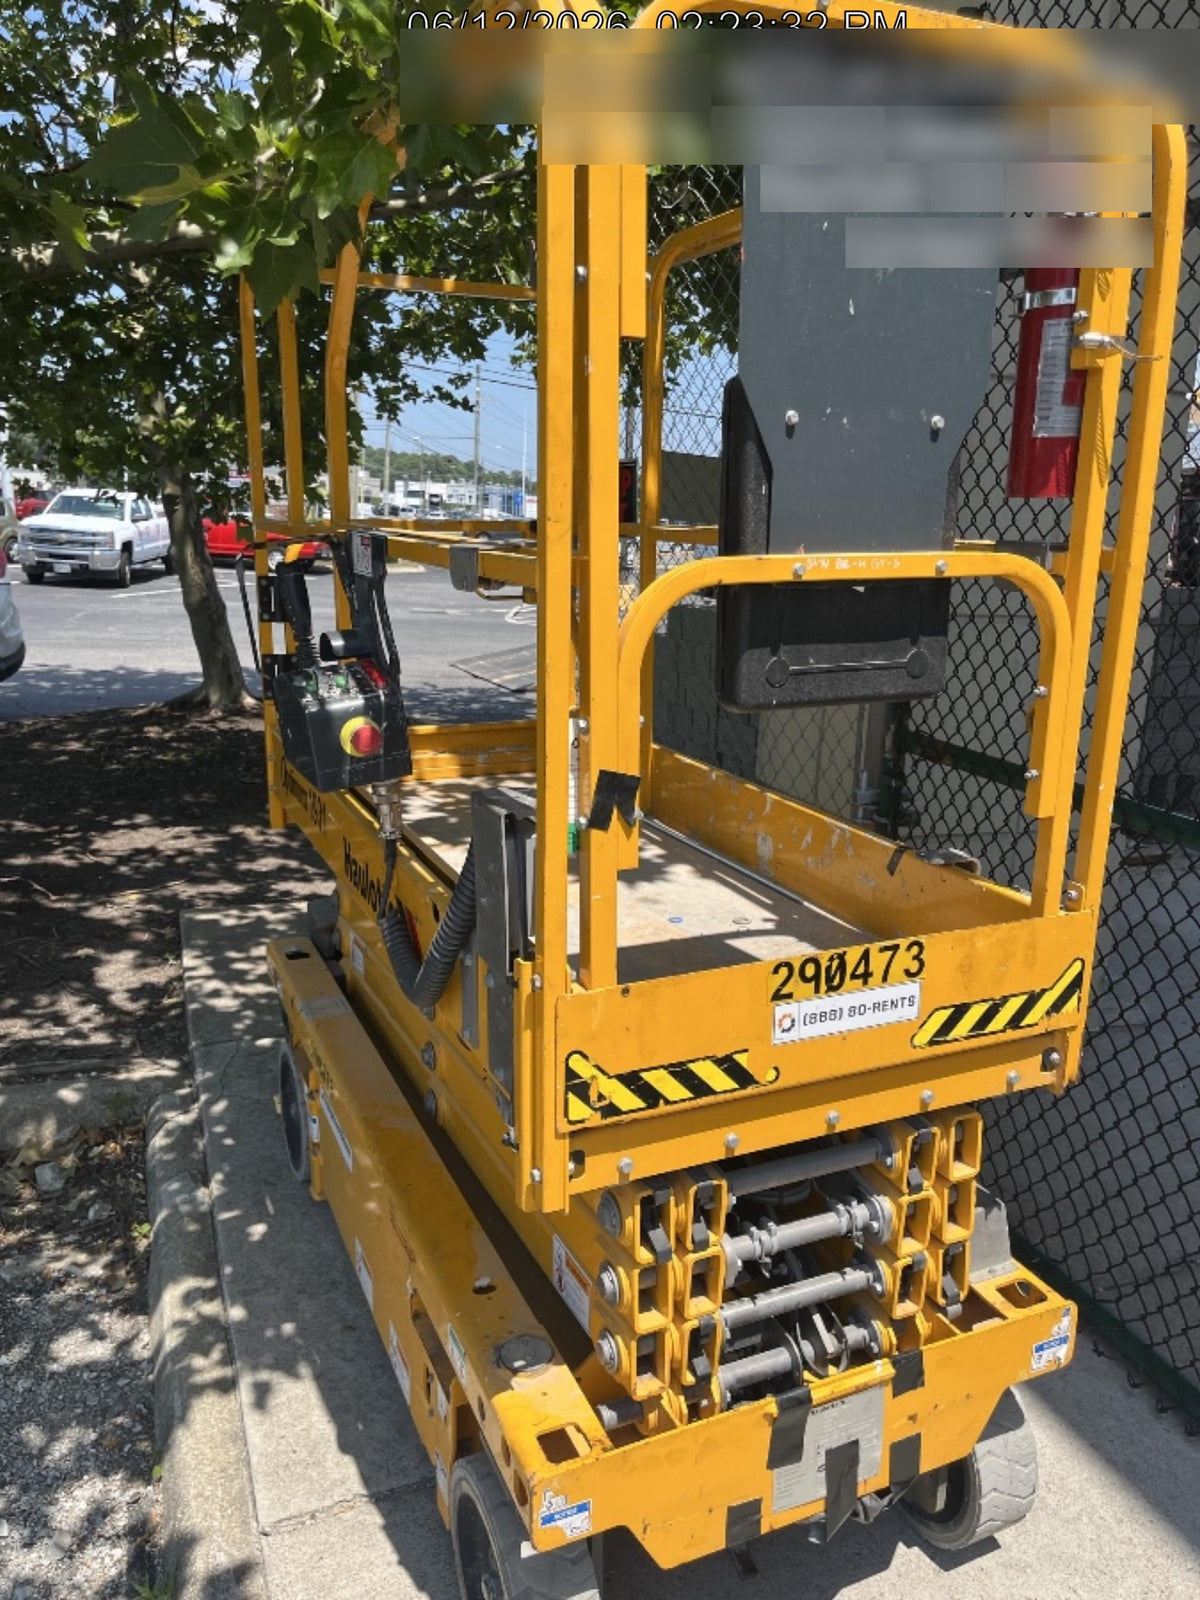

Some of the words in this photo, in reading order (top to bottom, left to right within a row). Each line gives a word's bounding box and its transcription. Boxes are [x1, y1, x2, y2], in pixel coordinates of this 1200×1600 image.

[770, 940, 925, 1002] 290473
[803, 1008, 843, 1026] (888)
[848, 995, 916, 1017] 80-RENTS
